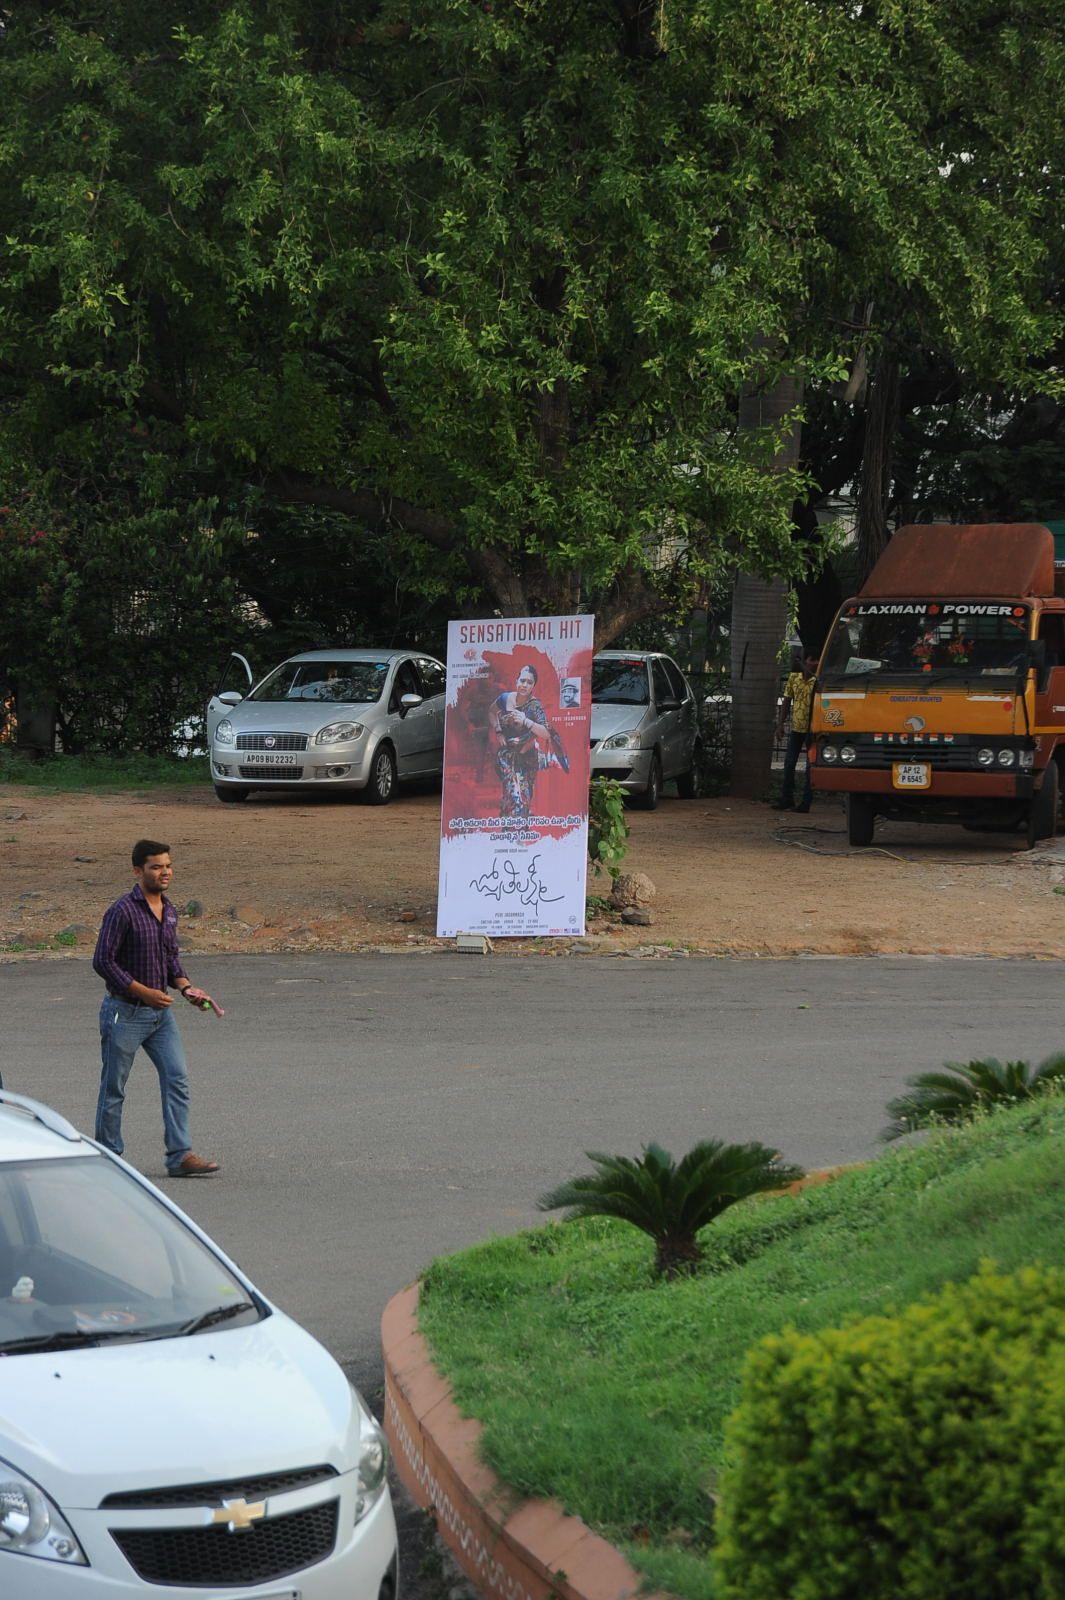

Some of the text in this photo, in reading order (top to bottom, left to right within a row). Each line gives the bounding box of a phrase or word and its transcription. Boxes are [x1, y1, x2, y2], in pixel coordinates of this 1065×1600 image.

[858, 605, 1012, 616] LAXMAN POWER
[460, 620, 582, 644] SENSATIONAL HIT
[873, 733, 955, 744] EICHER
[246, 755, 294, 764] AP09 BU 2232
[902, 765, 921, 774] AP 12
[901, 775, 907, 783] P
